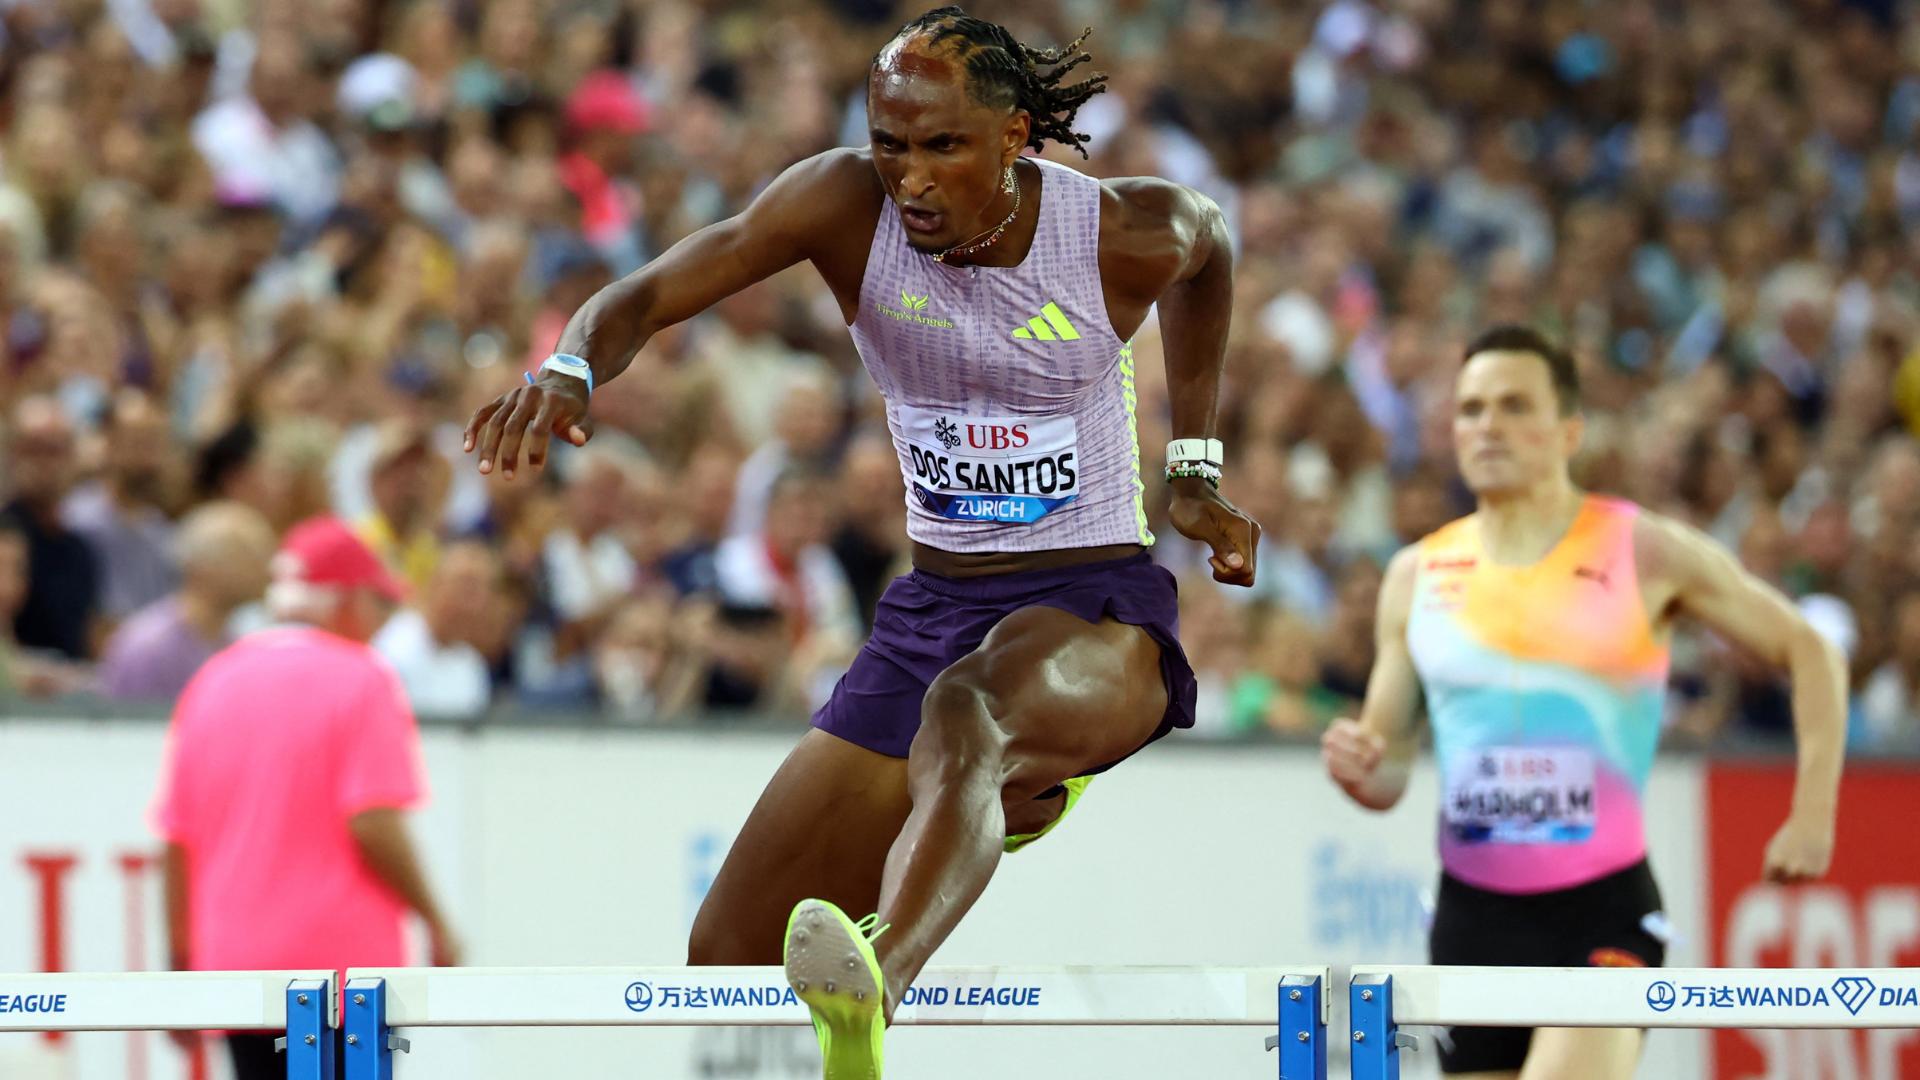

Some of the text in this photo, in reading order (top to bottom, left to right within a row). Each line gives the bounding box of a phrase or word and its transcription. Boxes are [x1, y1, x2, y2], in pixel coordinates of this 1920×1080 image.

[876, 302, 955, 329] Tirop's Angels
[965, 424, 1029, 450] UBS
[909, 443, 1076, 495] DOS SANTOS
[955, 500, 1026, 518] ZURICH
[0, 994, 67, 1013] EAGUE
[901, 987, 949, 1006] OND
[954, 987, 1041, 1006] LEAGUE
[1879, 987, 1920, 1006] DIA
